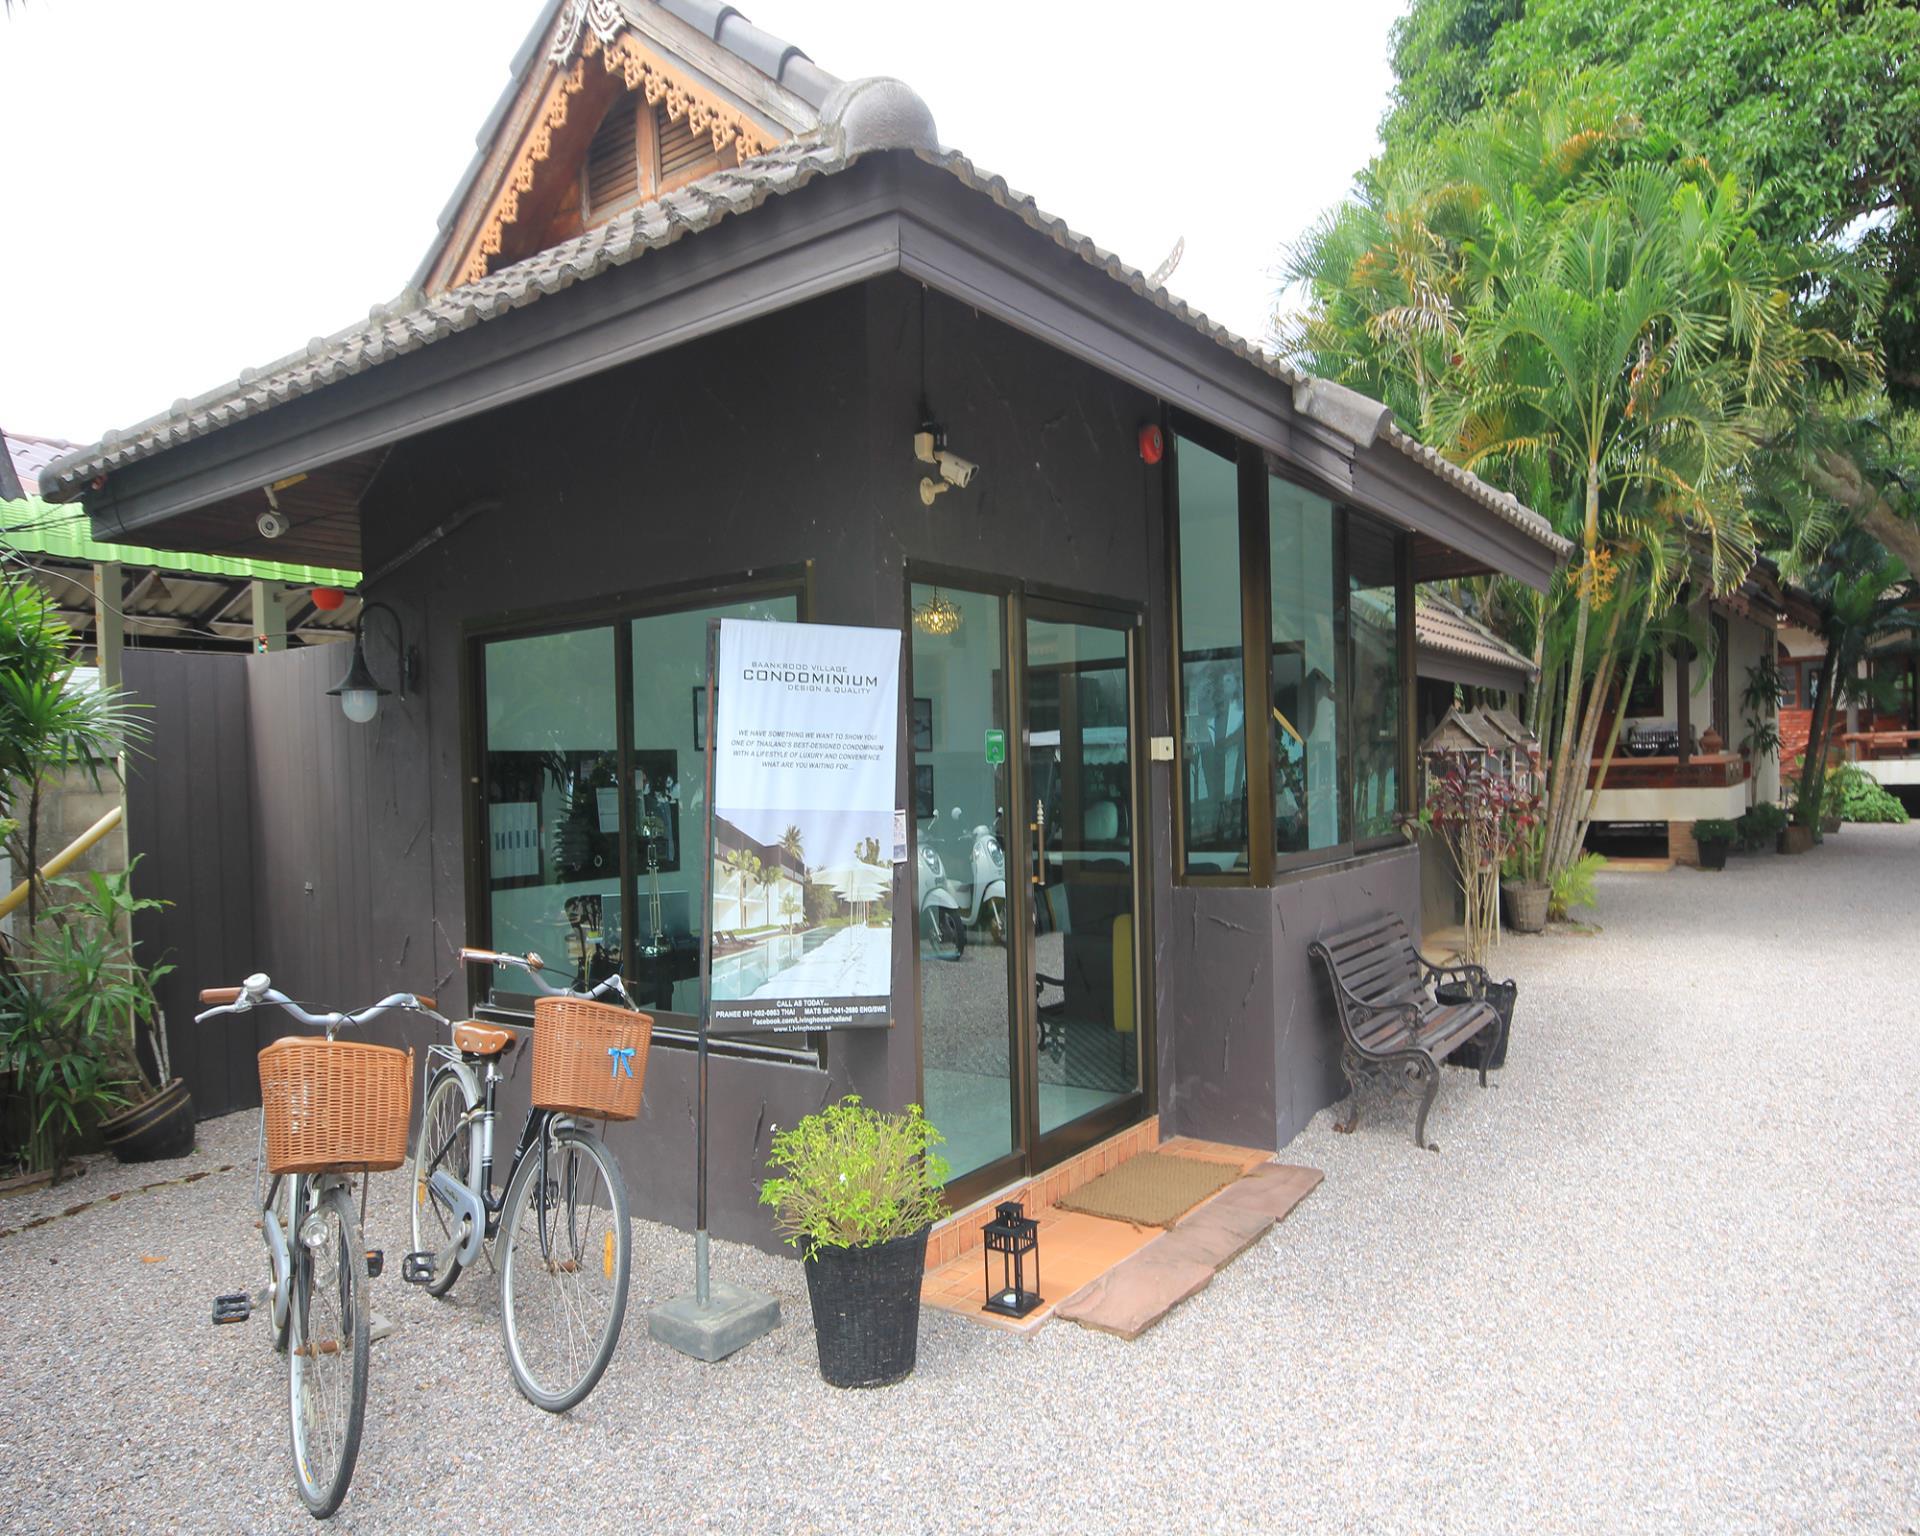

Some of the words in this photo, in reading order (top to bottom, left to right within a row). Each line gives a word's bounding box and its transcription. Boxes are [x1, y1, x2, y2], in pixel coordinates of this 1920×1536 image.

[752, 661, 808, 670] BAANKROOD
[811, 664, 848, 673] VILLAGE
[743, 669, 878, 687] CONDOMINIUM
[834, 687, 871, 695] QUALITY
[738, 729, 748, 737] WE
[757, 740, 792, 748] THAILAND'S
[793, 742, 841, 750] BEST-DESIGNED
[843, 743, 885, 751] CONDOMINIUM
[776, 999, 793, 1007] CALL
[715, 1010, 741, 1018] PRANEE
[781, 1008, 796, 1016] THAI
[804, 1007, 821, 1015] MATS
